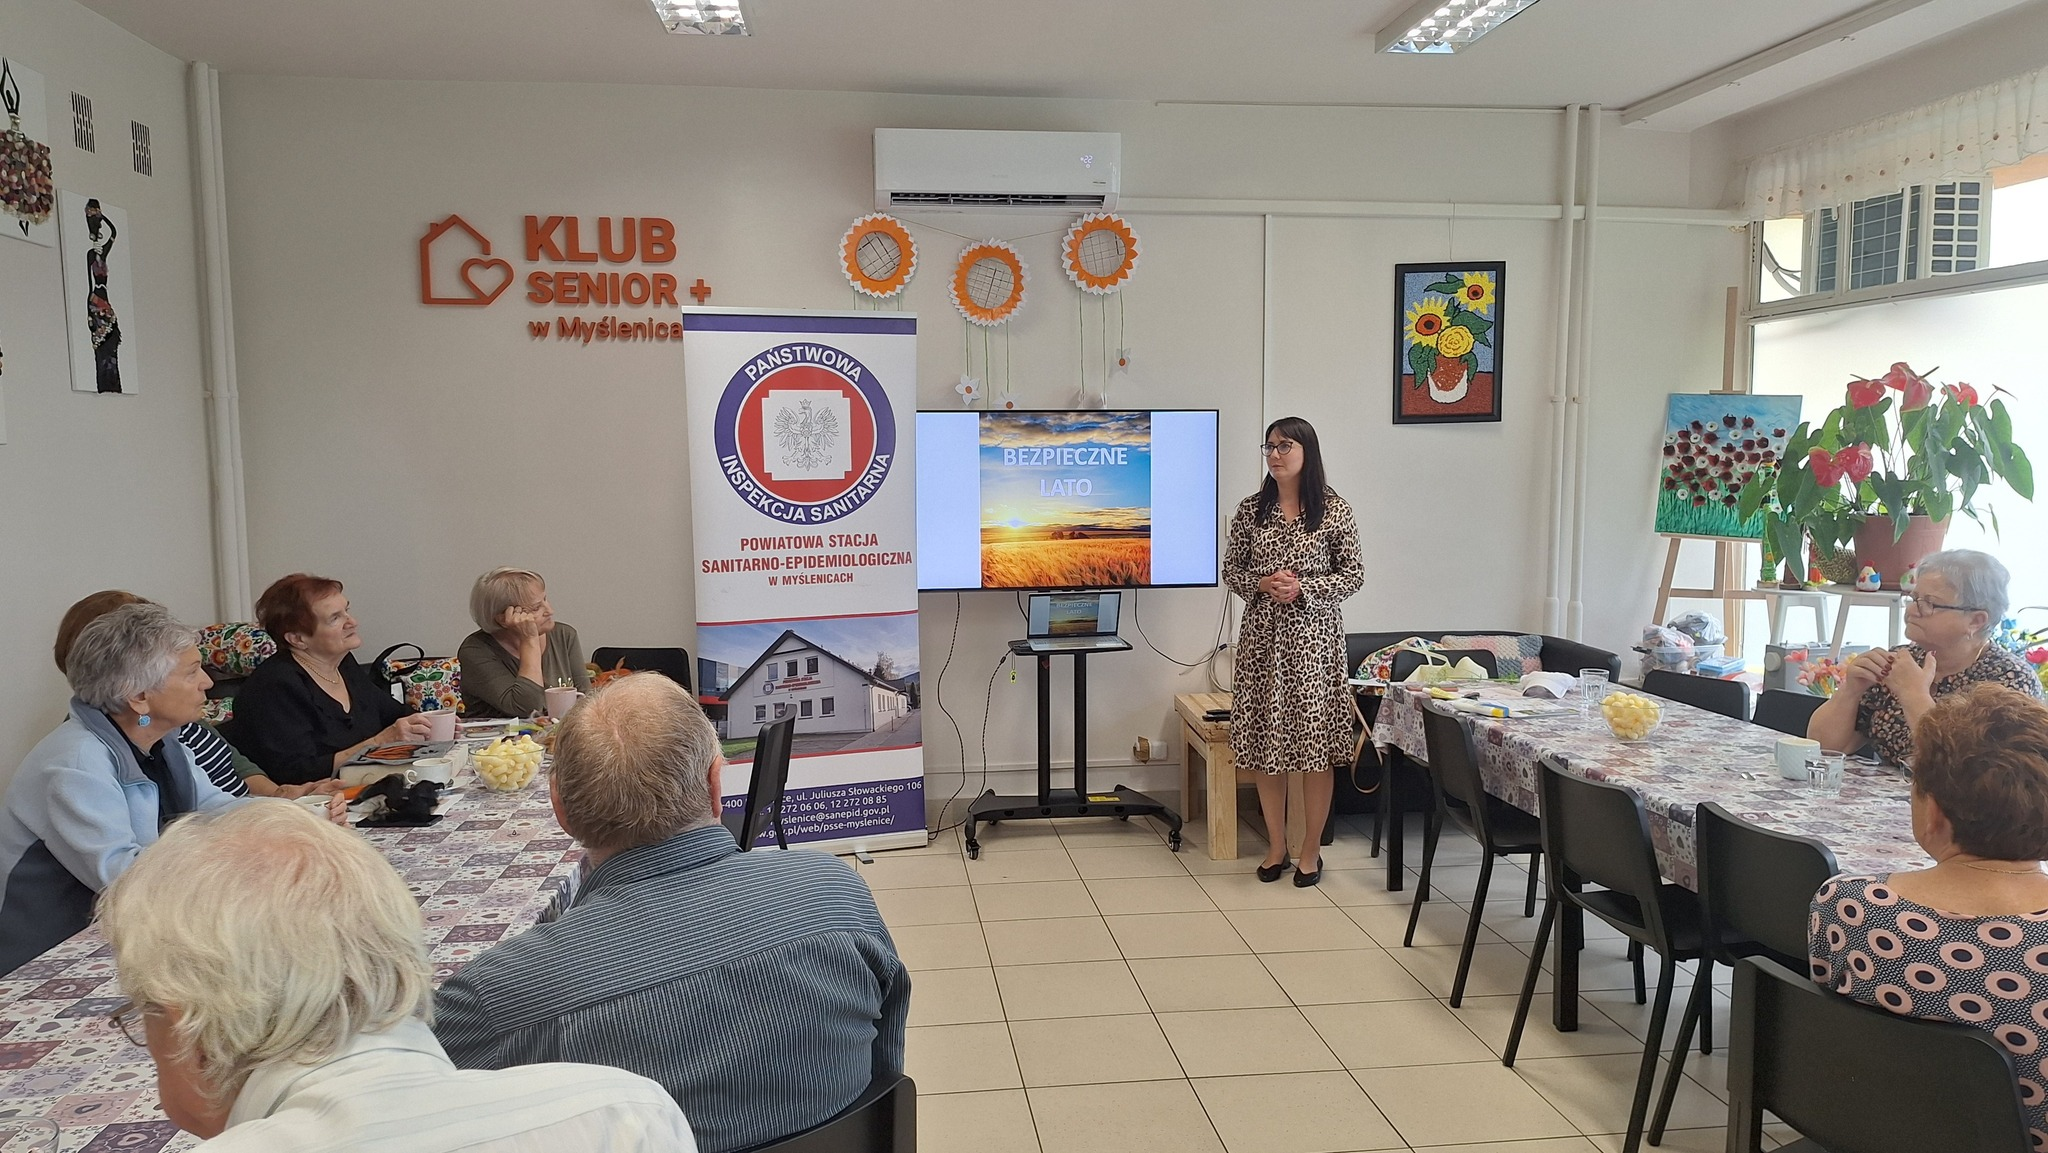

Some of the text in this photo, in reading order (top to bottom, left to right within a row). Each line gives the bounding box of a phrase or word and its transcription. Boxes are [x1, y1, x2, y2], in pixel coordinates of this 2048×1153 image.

[525, 215, 677, 263] KLUB
[527, 271, 678, 305] SENIOR
[529, 315, 683, 343] w Myślenica
[744, 345, 862, 382] PAŃSTWOWA
[1003, 447, 1128, 467] BEZPIECZNE
[721, 453, 891, 522] INSPEKCJA SANITARNA
[1040, 478, 1092, 497] LATO
[740, 533, 878, 551] POWIATOWA STACJA
[702, 551, 913, 573] SANITARNO-EPIDEMIOLOGICZNA
[768, 572, 853, 586] W MYŚLENICACH
[721, 799, 743, 809] -400
[797, 792, 808, 801] ul.
[810, 789, 846, 800] Juliusza
[848, 784, 904, 796] Słowackiego
[906, 781, 922, 790] 106
[780, 804, 798, 814] 272
[800, 802, 812, 812] 06
[814, 801, 828, 811] 06,
[831, 800, 841, 809] 12
[843, 798, 860, 807] 272
[862, 796, 874, 805] 08
[875, 795, 887, 804] 85
